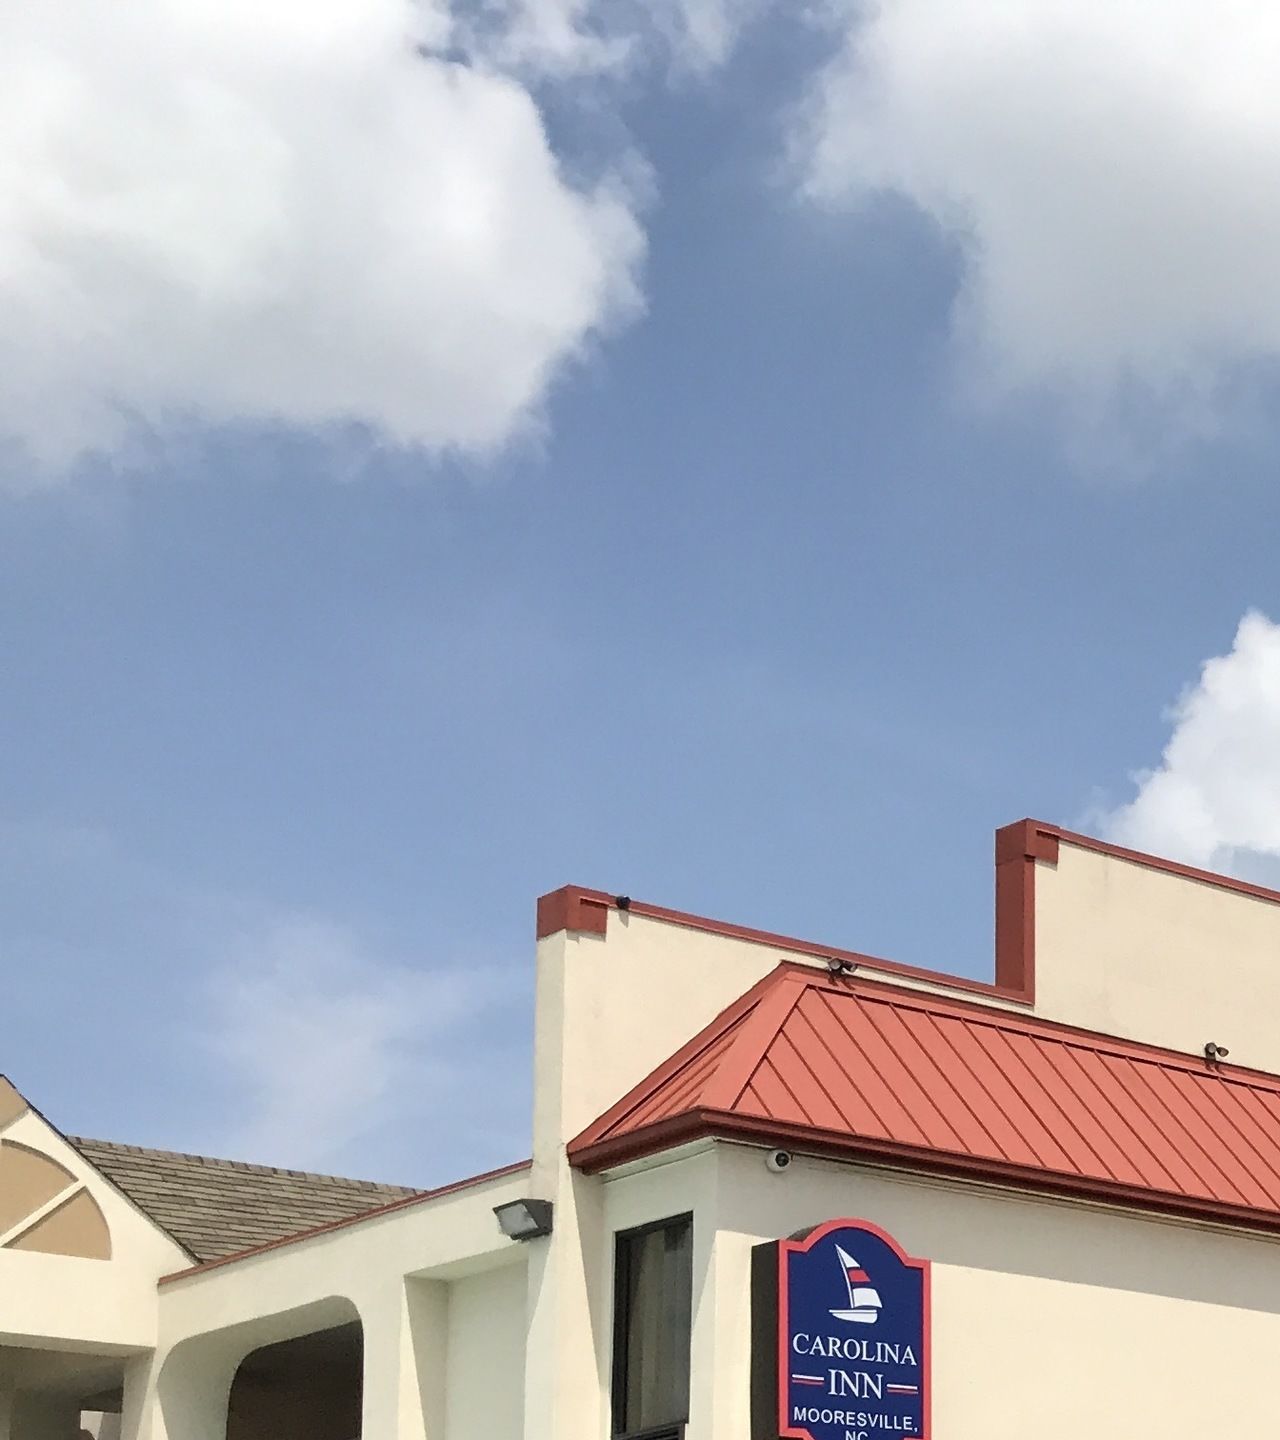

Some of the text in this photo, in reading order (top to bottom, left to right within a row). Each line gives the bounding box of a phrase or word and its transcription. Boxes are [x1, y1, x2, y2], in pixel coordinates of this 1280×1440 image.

[792, 1333, 917, 1366] CAROLINA
[828, 1369, 883, 1399] INN
[793, 1406, 918, 1433] MOORESVILLE,
